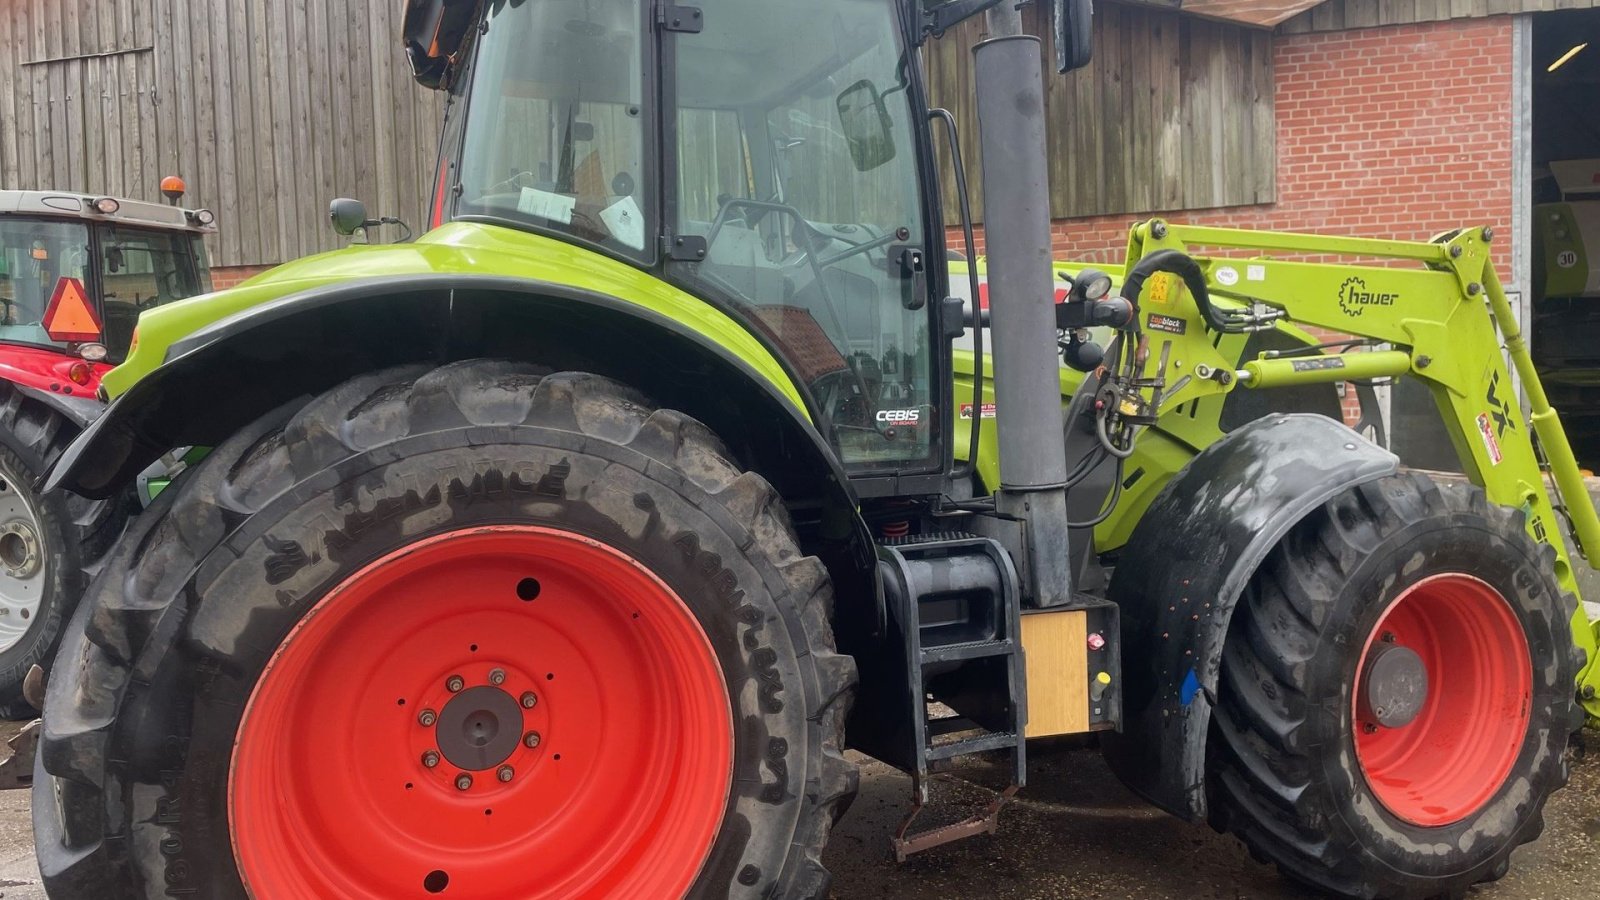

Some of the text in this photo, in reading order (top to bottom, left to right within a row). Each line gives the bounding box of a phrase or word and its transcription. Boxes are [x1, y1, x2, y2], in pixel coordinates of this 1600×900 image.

[1560, 253, 1574, 266] 30
[1348, 286, 1399, 306] hauer
[876, 410, 919, 421] CEBIS
